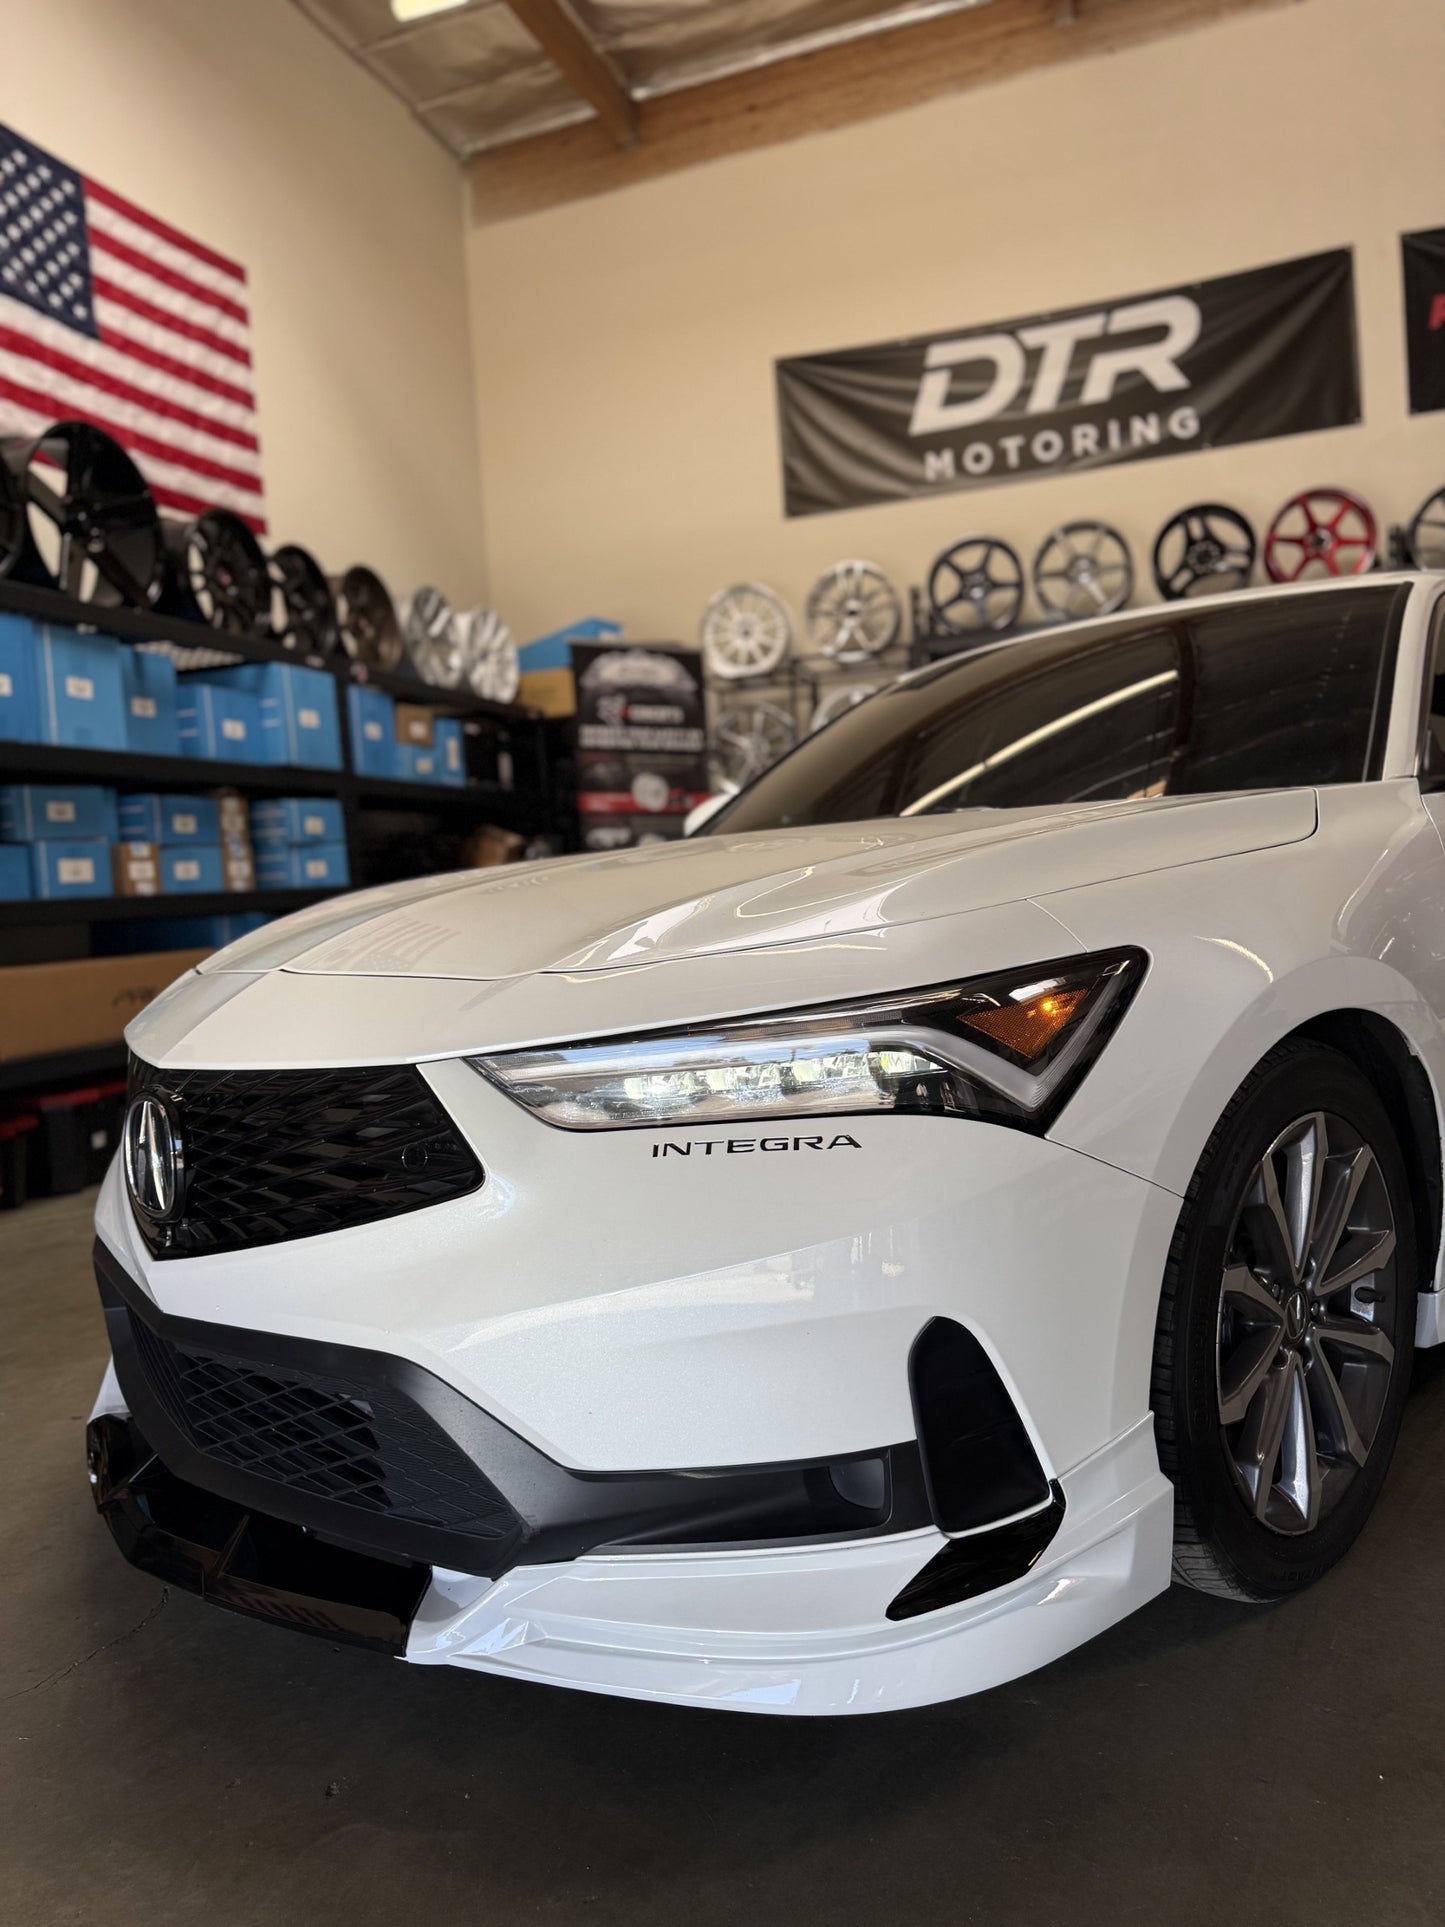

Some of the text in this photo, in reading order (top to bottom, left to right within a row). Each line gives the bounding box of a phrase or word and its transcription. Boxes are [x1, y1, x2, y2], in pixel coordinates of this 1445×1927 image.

[909, 295, 1202, 436] DTR
[925, 406, 1201, 481] MOTORING
[652, 1134, 863, 1158] INTEGRA
